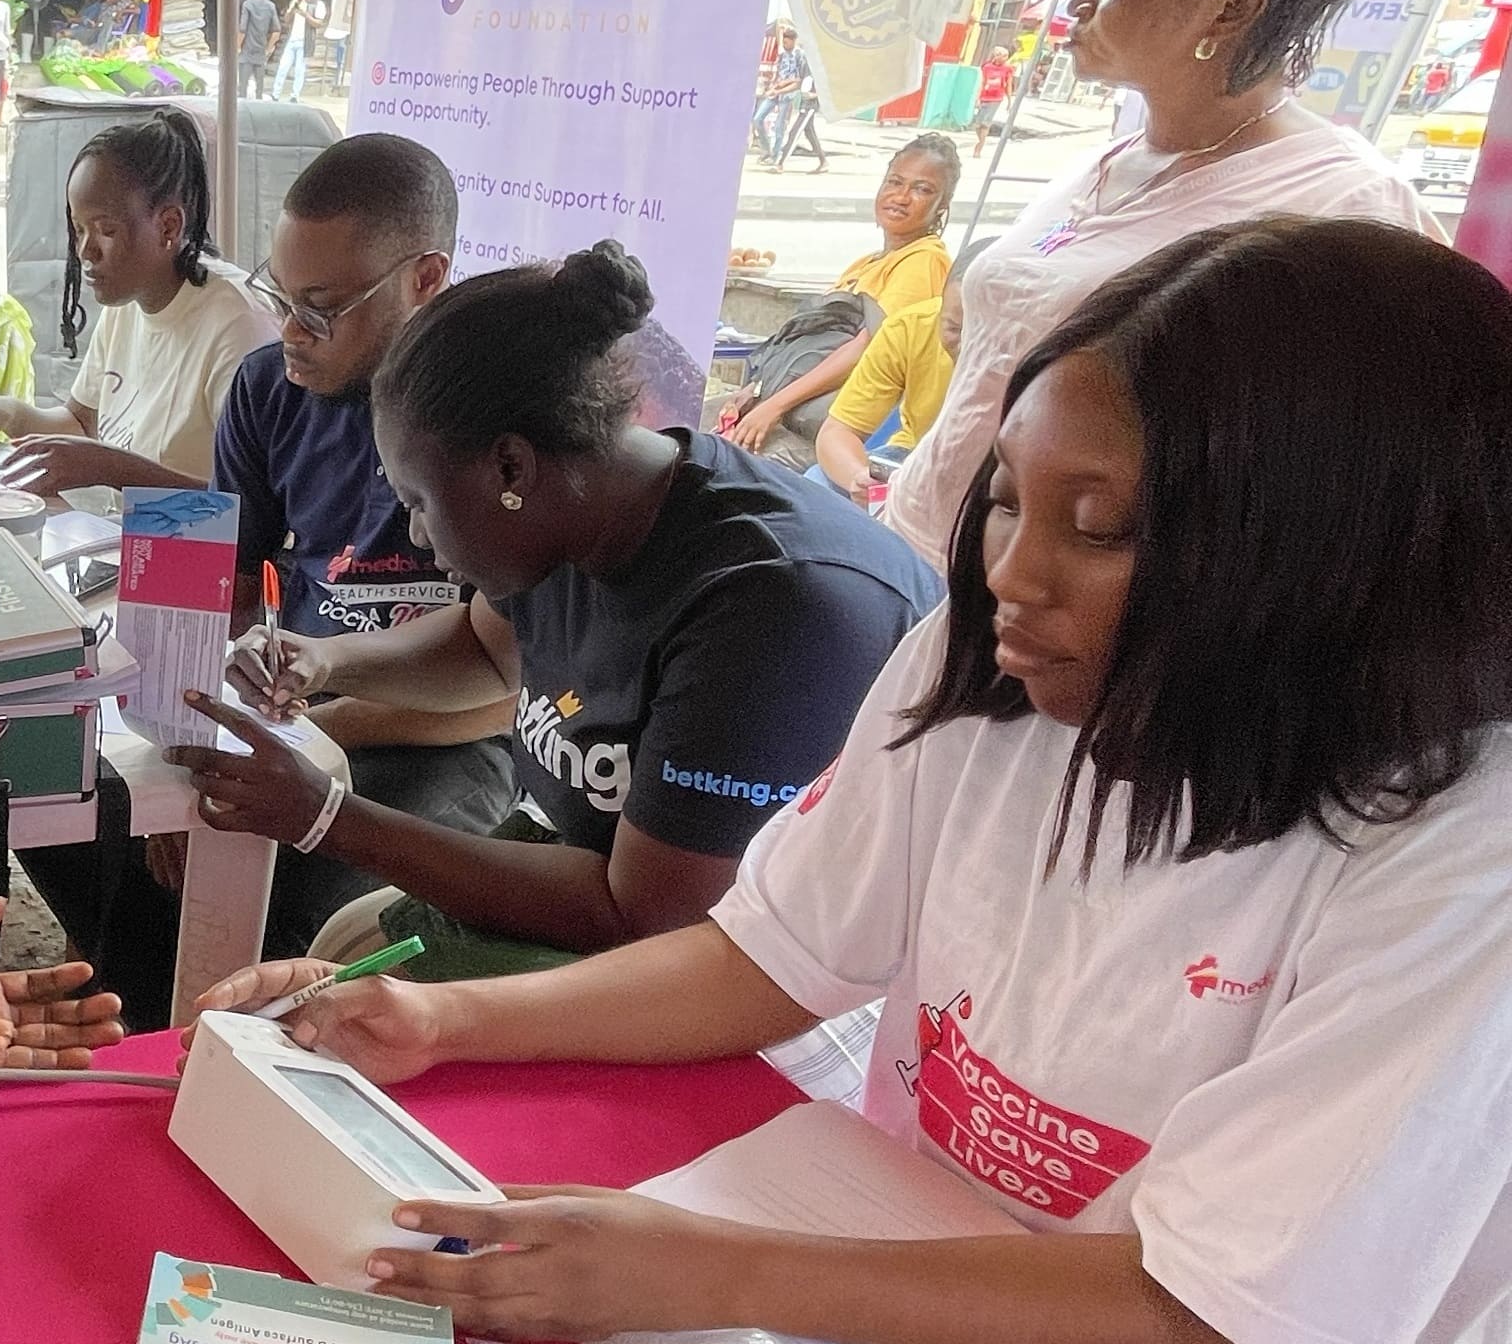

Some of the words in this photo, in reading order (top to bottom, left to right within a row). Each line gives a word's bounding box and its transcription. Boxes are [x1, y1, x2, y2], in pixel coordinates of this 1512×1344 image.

[472, 10, 651, 34] FOUNDATION
[389, 66, 478, 95] Empowering
[483, 72, 538, 98] People
[541, 76, 615, 105] Through
[621, 82, 699, 110] Support
[369, 98, 395, 116] and
[400, 99, 491, 129] Opportunity.
[448, 168, 496, 197] ignity
[501, 179, 531, 199] and
[534, 181, 607, 211] Support
[612, 192, 635, 215] for
[638, 199, 666, 222] All.
[476, 243, 508, 262] and
[453, 265, 475, 283] fo
[389, 586, 456, 599] SERVICE
[318, 599, 384, 632] DOCTO
[515, 686, 631, 812] etking
[951, 1028, 1100, 1154] Vaccine
[969, 1106, 1072, 1181] Save
[210, 1317, 261, 1338] Antigen
